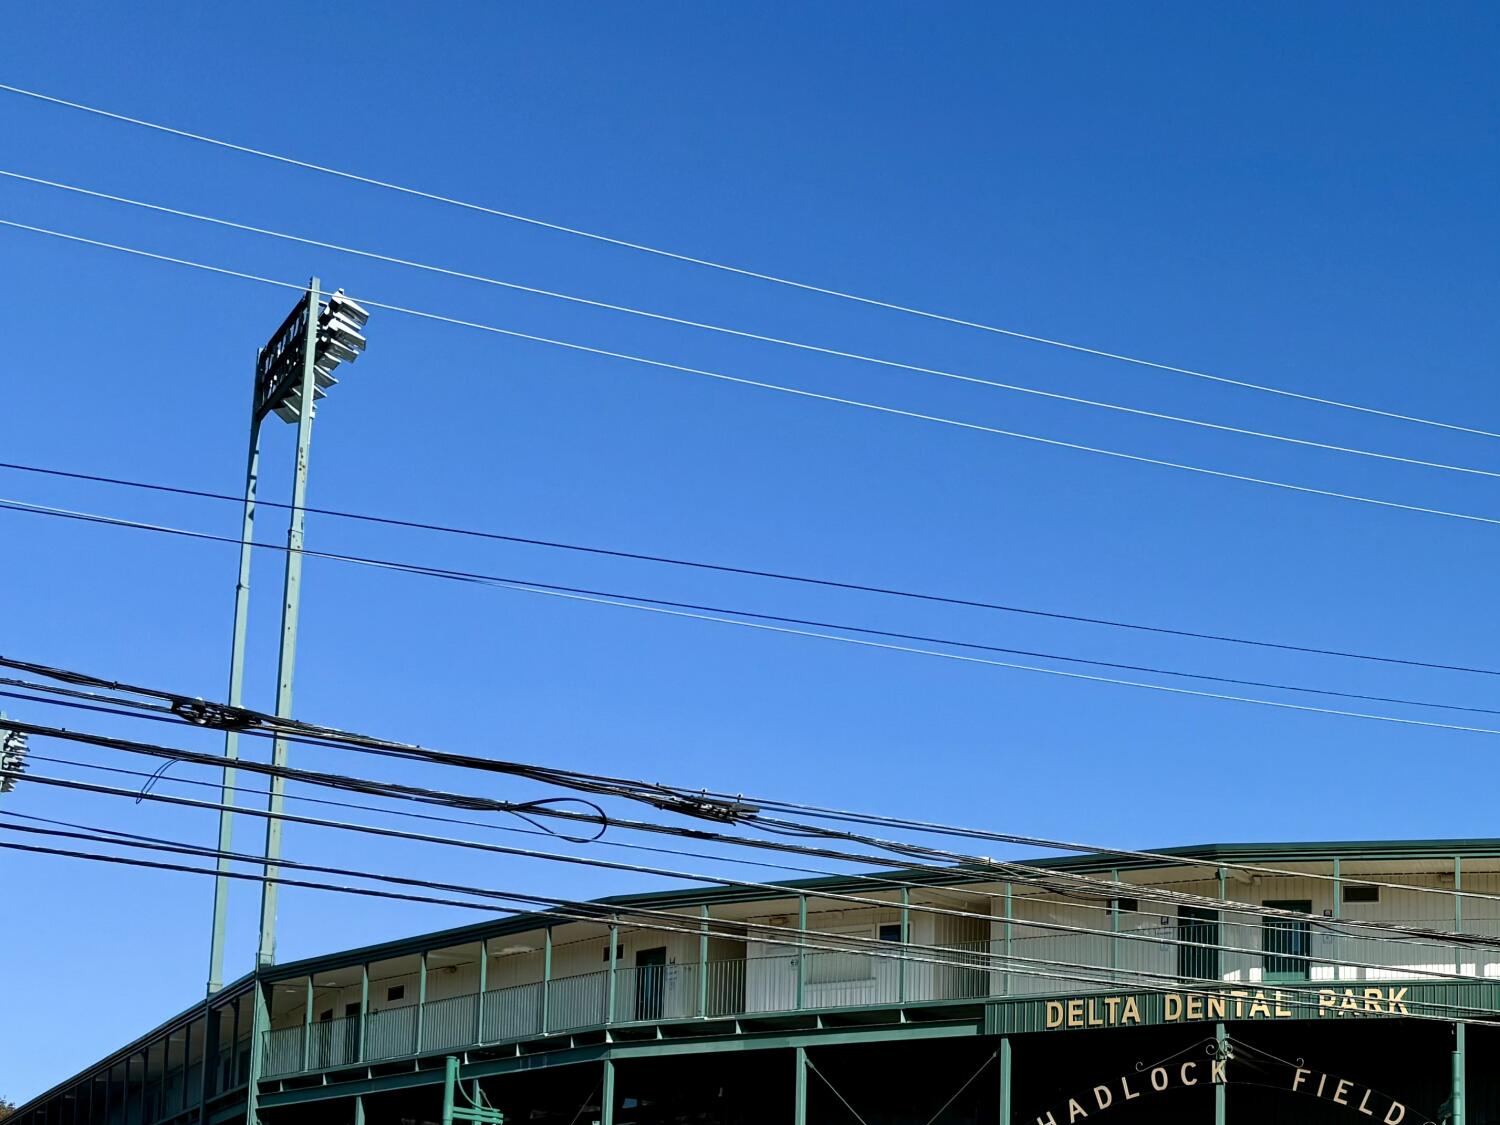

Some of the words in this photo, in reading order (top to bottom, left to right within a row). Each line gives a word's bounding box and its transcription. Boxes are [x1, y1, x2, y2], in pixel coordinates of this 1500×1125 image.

[1046, 996, 1141, 1029] DELTA
[1164, 990, 1292, 1021] DENTAL
[1319, 987, 1409, 1017] PARK
[1293, 1068, 1405, 1125] FIELD
